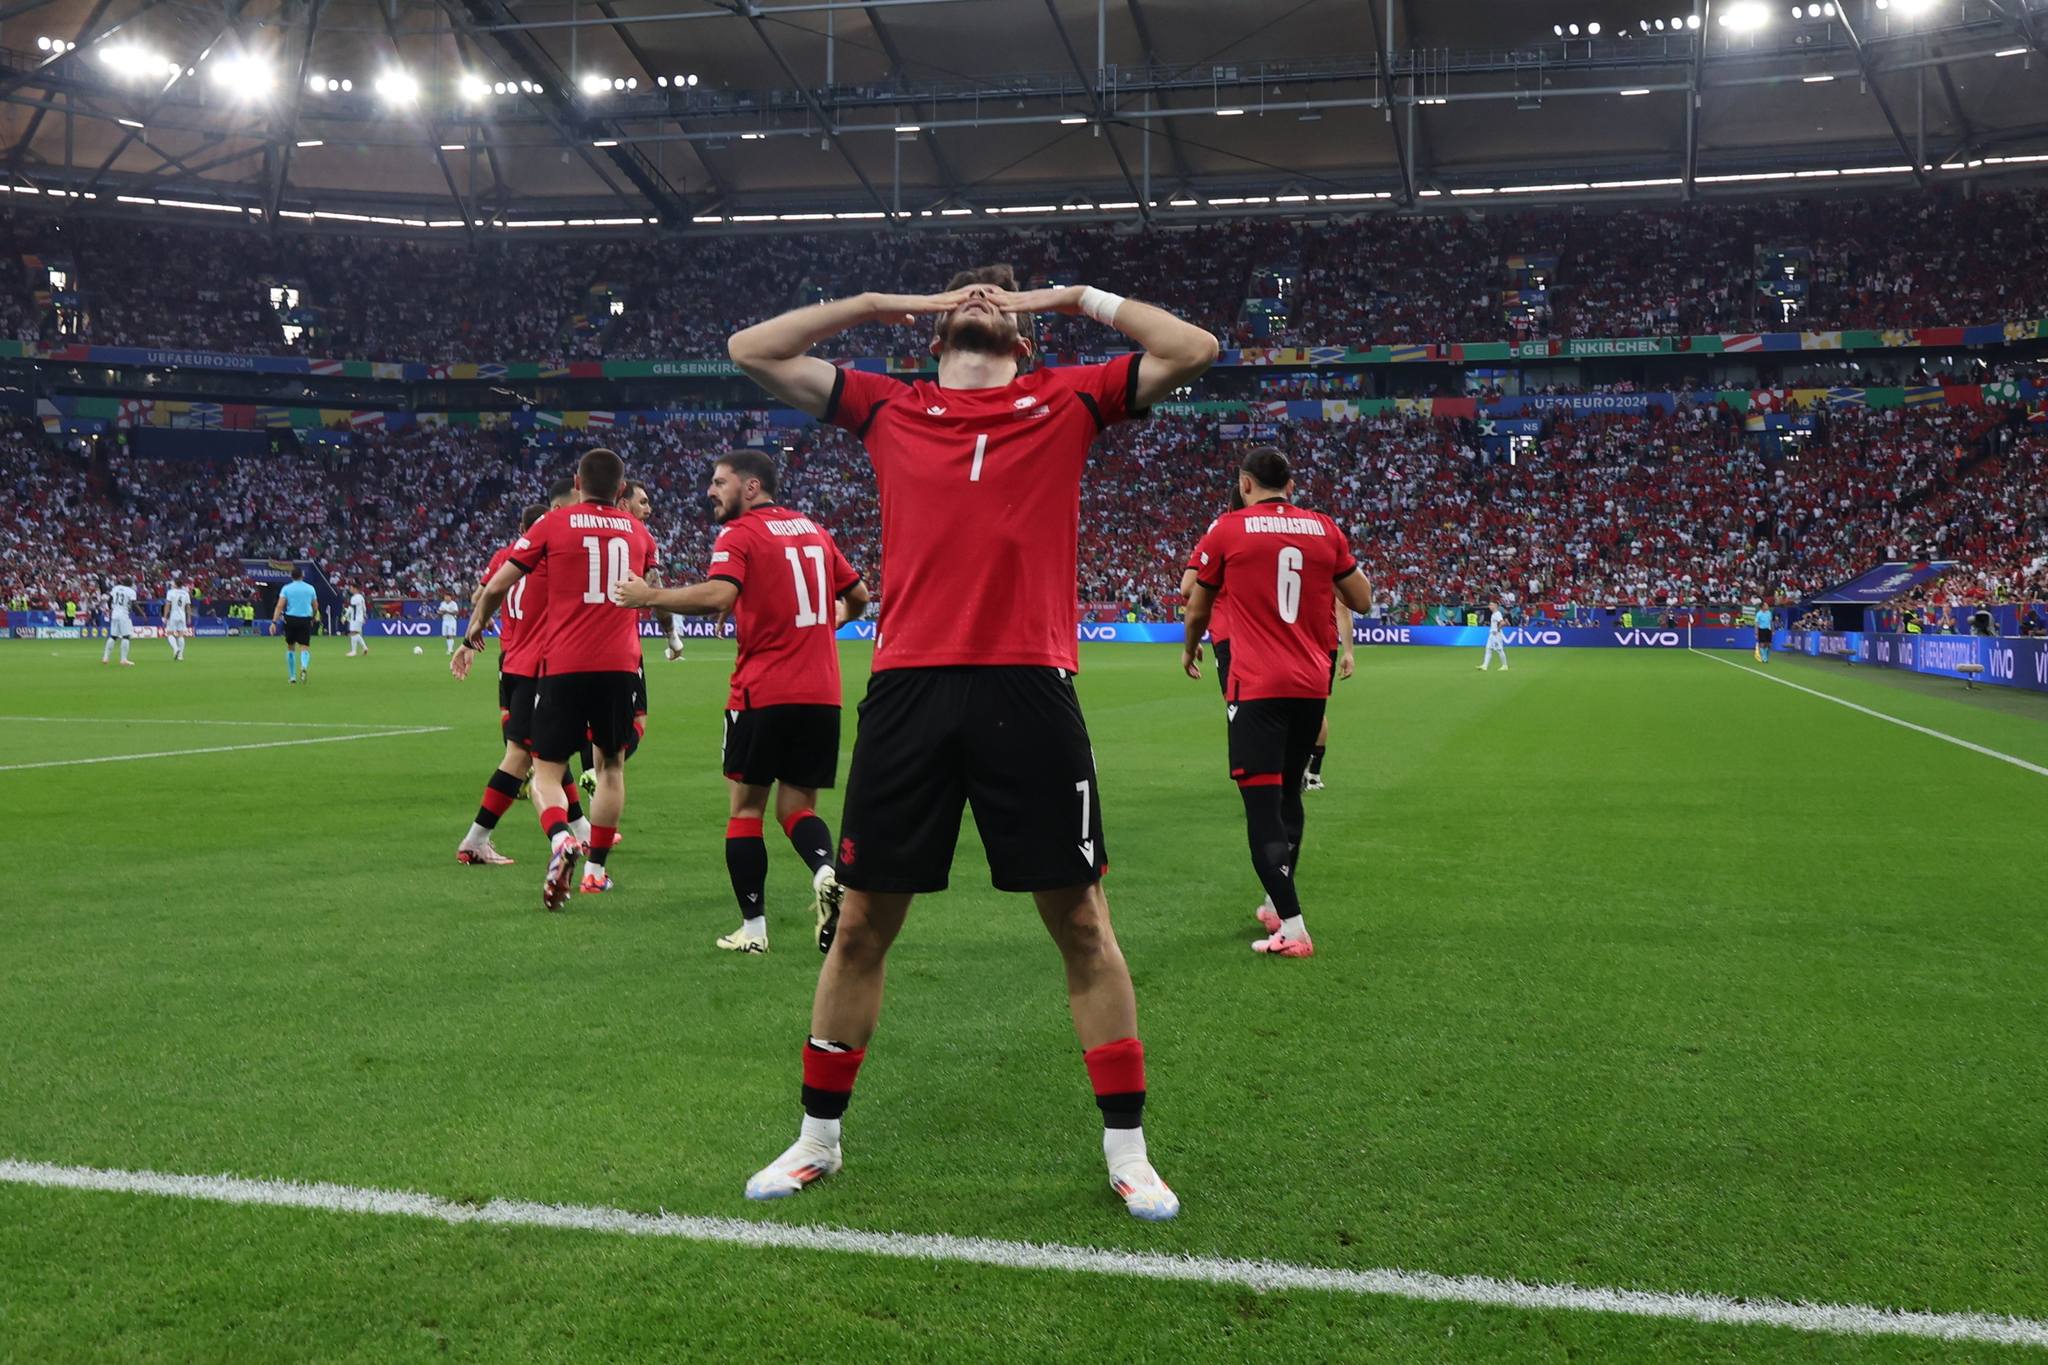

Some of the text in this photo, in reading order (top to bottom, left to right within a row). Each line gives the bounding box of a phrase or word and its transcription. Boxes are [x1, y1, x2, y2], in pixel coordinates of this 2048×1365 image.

[1522, 341, 1660, 356] GENKIRCHEN
[184, 355, 224, 366] EURO
[224, 357, 254, 369] 2024
[652, 363, 742, 374] GELSENKIRC
[1573, 397, 1615, 409] EURO
[1616, 396, 1649, 408] 2024
[583, 536, 630, 606] 10
[785, 545, 828, 628] 17
[1277, 546, 1303, 624] 6
[381, 620, 432, 635] vivo
[856, 622, 877, 637] vi
[1077, 623, 1117, 640] ivo
[1501, 628, 1561, 645] vivo
[1614, 628, 1679, 646] vivo
[1988, 641, 2014, 679] vivo
[2035, 643, 2048, 684] vi
